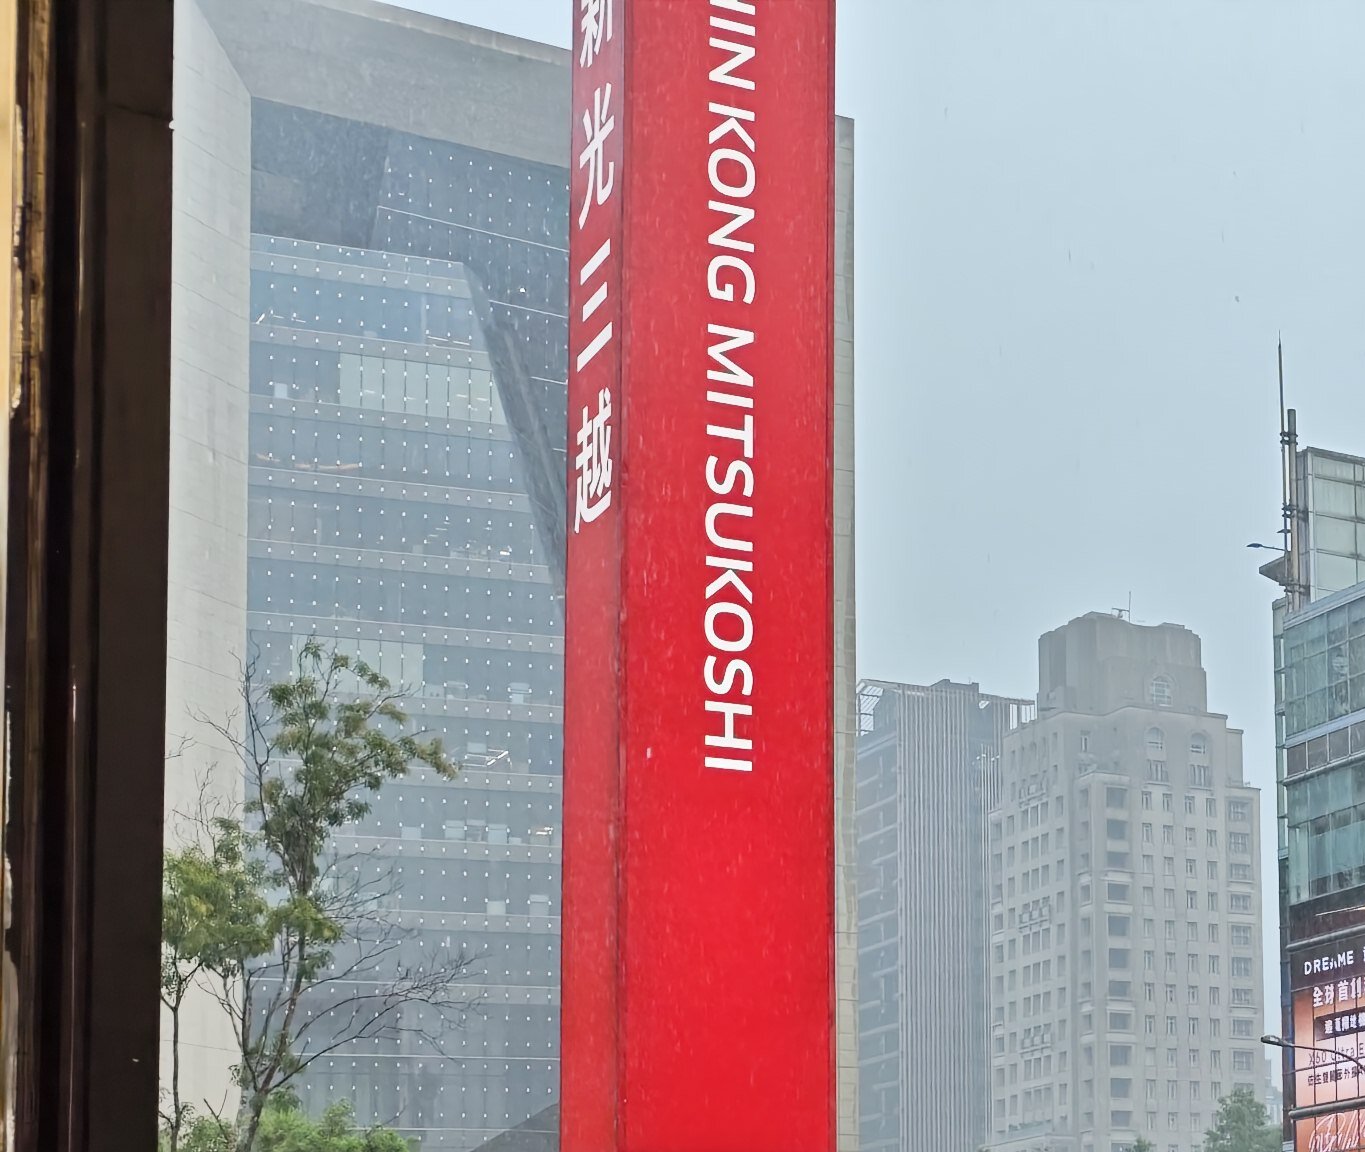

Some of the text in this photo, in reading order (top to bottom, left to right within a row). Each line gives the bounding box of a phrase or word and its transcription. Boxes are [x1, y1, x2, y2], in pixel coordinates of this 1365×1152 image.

[575, 0, 615, 534] 新光三越
[707, 102, 755, 305] KONG
[704, 323, 754, 771] MITSUKOSHI
[1303, 950, 1355, 976] DREAME
